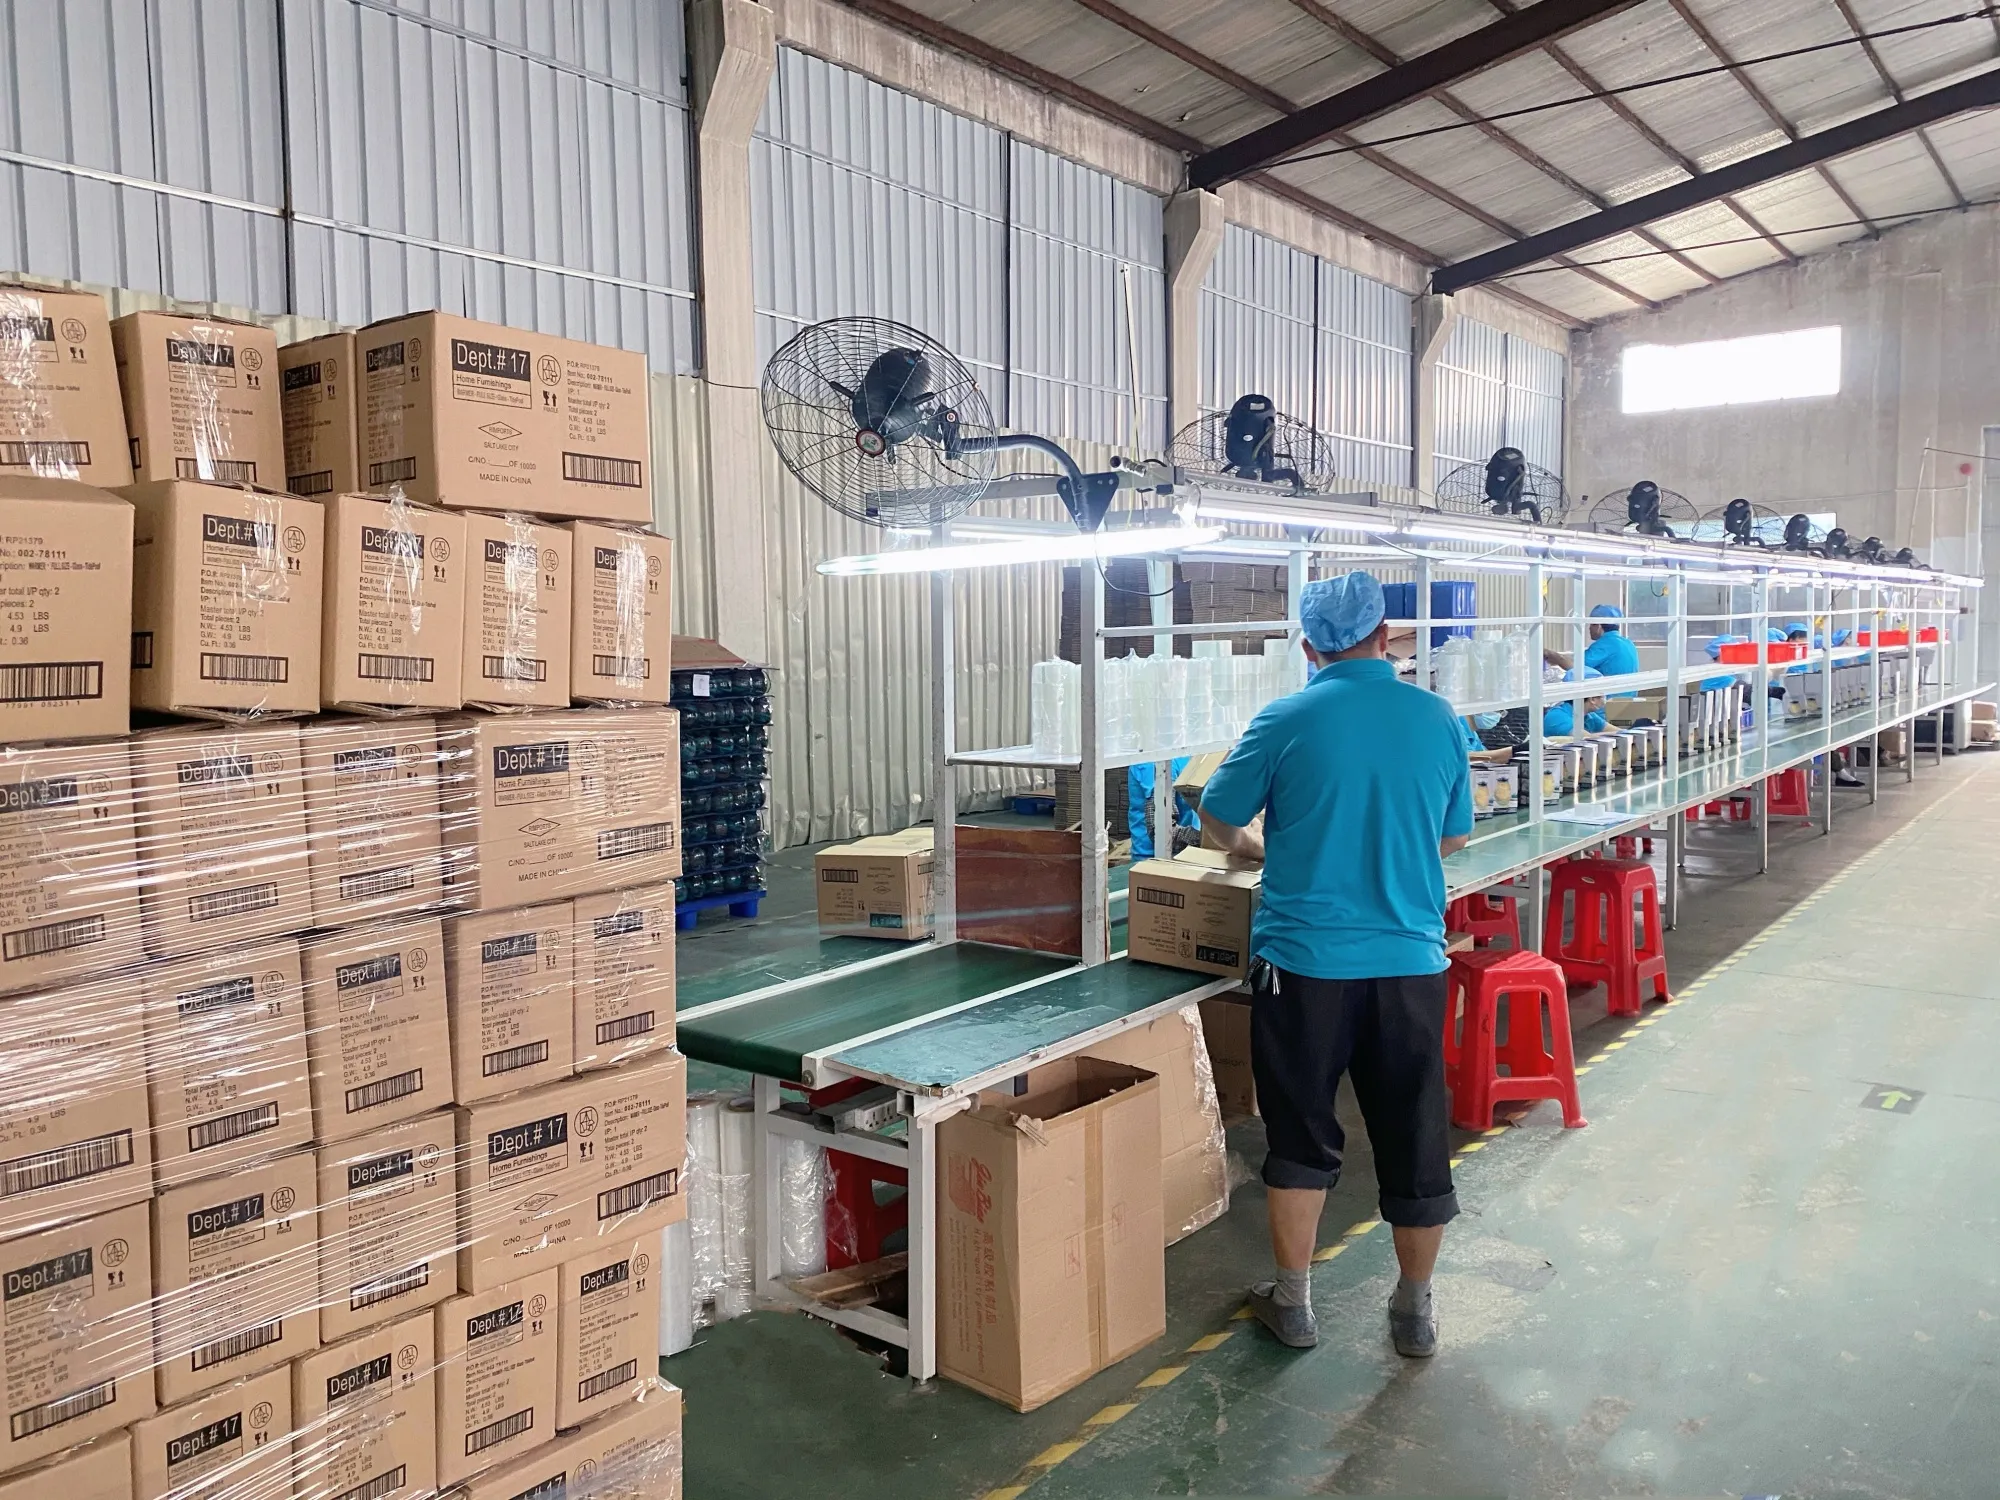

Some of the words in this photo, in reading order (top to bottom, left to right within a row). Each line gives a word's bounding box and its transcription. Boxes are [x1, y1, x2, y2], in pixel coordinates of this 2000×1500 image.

[457, 343, 506, 373] Dept.#
[511, 352, 527, 374] 17
[456, 374, 476, 384] Home
[477, 377, 512, 390] Furnishings
[480, 473, 500, 482] MADE
[511, 476, 532, 485] CHINA
[207, 518, 253, 543] Dept.#
[18, 550, 66, 559] 002-78111
[9, 587, 24, 596] total
[54, 587, 60, 596] 2
[29, 600, 34, 608] 2
[200, 605, 222, 614] Master
[8, 612, 24, 620] 4.53
[33, 611, 49, 620] LBS
[10, 624, 23, 633] 4.9
[33, 624, 50, 633] LBS
[11, 637, 29, 646] 0.36
[498, 746, 546, 774] Dept.#
[550, 746, 565, 766] 17
[519, 872, 538, 882] MADE
[340, 964, 381, 986] Dept.#
[385, 958, 399, 974] 17
[185, 1088, 198, 1096] Total
[206, 1090, 218, 1098] 4.53
[225, 1085, 237, 1093] LBS
[50, 1108, 66, 1119] LBS
[30, 1124, 47, 1136] 0.36
[494, 1122, 542, 1156] Dept.#
[548, 1118, 564, 1140] 17
[493, 1162, 512, 1173] Home
[513, 1152, 548, 1167] Furnishings
[193, 1203, 240, 1233] Dept.#
[245, 1198, 260, 1217] 17
[544, 1224, 553, 1233] OF
[555, 1219, 571, 1230] 10000
[8, 1259, 64, 1294] Dept.#
[70, 1252, 88, 1274] 17
[584, 1267, 614, 1291] Dept.#
[616, 1262, 627, 1279] 17
[470, 1310, 506, 1336] Dept.#
[509, 1304, 523, 1322] 17
[331, 1364, 371, 1396] Dept.#
[375, 1358, 388, 1377] 17
[171, 1424, 218, 1461] Dept.#
[223, 1416, 239, 1437] 17
[550, 1476, 563, 1494] 17
